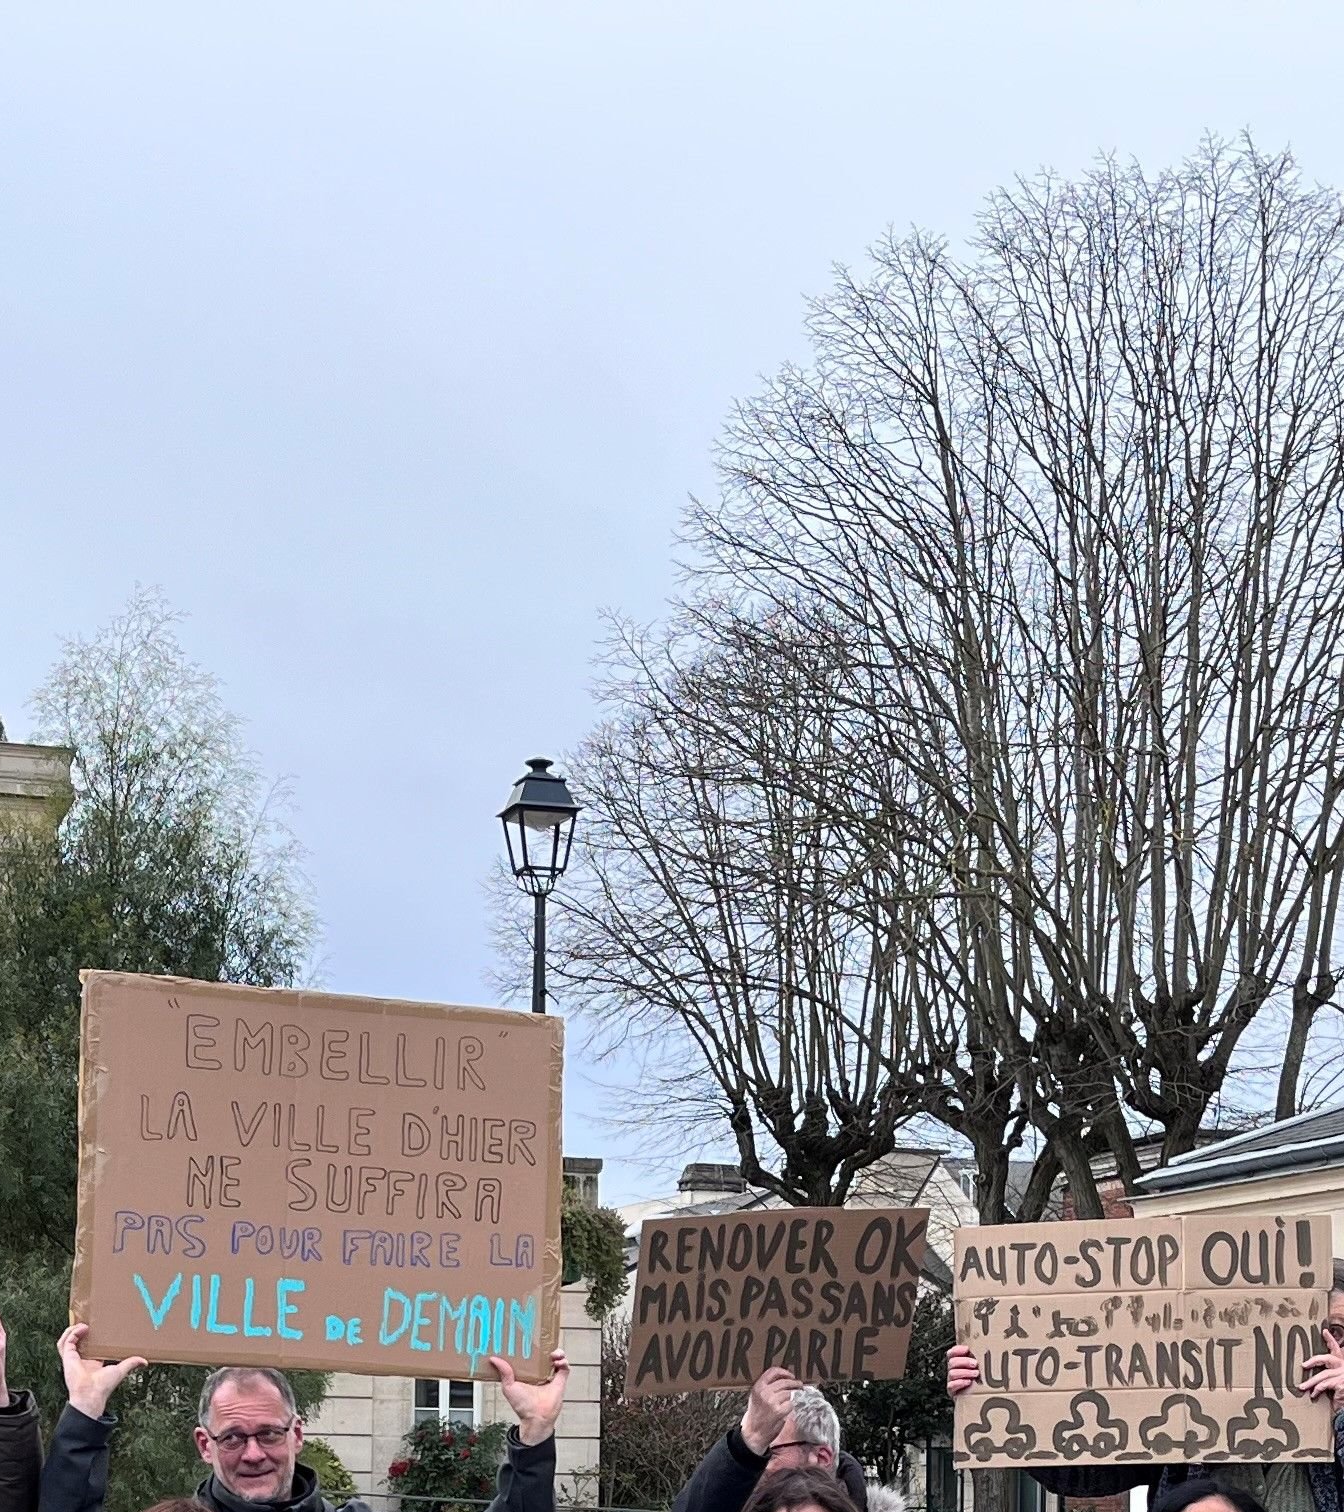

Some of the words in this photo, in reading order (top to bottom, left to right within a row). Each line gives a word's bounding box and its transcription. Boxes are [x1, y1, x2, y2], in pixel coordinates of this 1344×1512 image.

[140, 1091, 198, 1142] LA
[231, 1100, 375, 1156] VILLE
[401, 1105, 536, 1167] D'HIER
[186, 1154, 242, 1209] NE
[285, 1158, 503, 1223] SUFFIRA
[113, 1210, 207, 1258] PAS
[231, 1220, 323, 1262] POUR
[342, 1229, 461, 1268] FAIRE
[489, 1233, 535, 1269] LA
[648, 1217, 838, 1279] RENOVER
[856, 1216, 928, 1279] OK
[959, 1233, 1180, 1289] AUTO-STOP
[133, 1272, 305, 1340] VILLE
[378, 1286, 536, 1360] DEMAIN
[639, 1274, 731, 1325] MAIS
[739, 1276, 813, 1320] PAS
[818, 1280, 918, 1328] SANS
[635, 1318, 754, 1388] AVOIR
[973, 1337, 1243, 1392] UTO-TRANSIT
